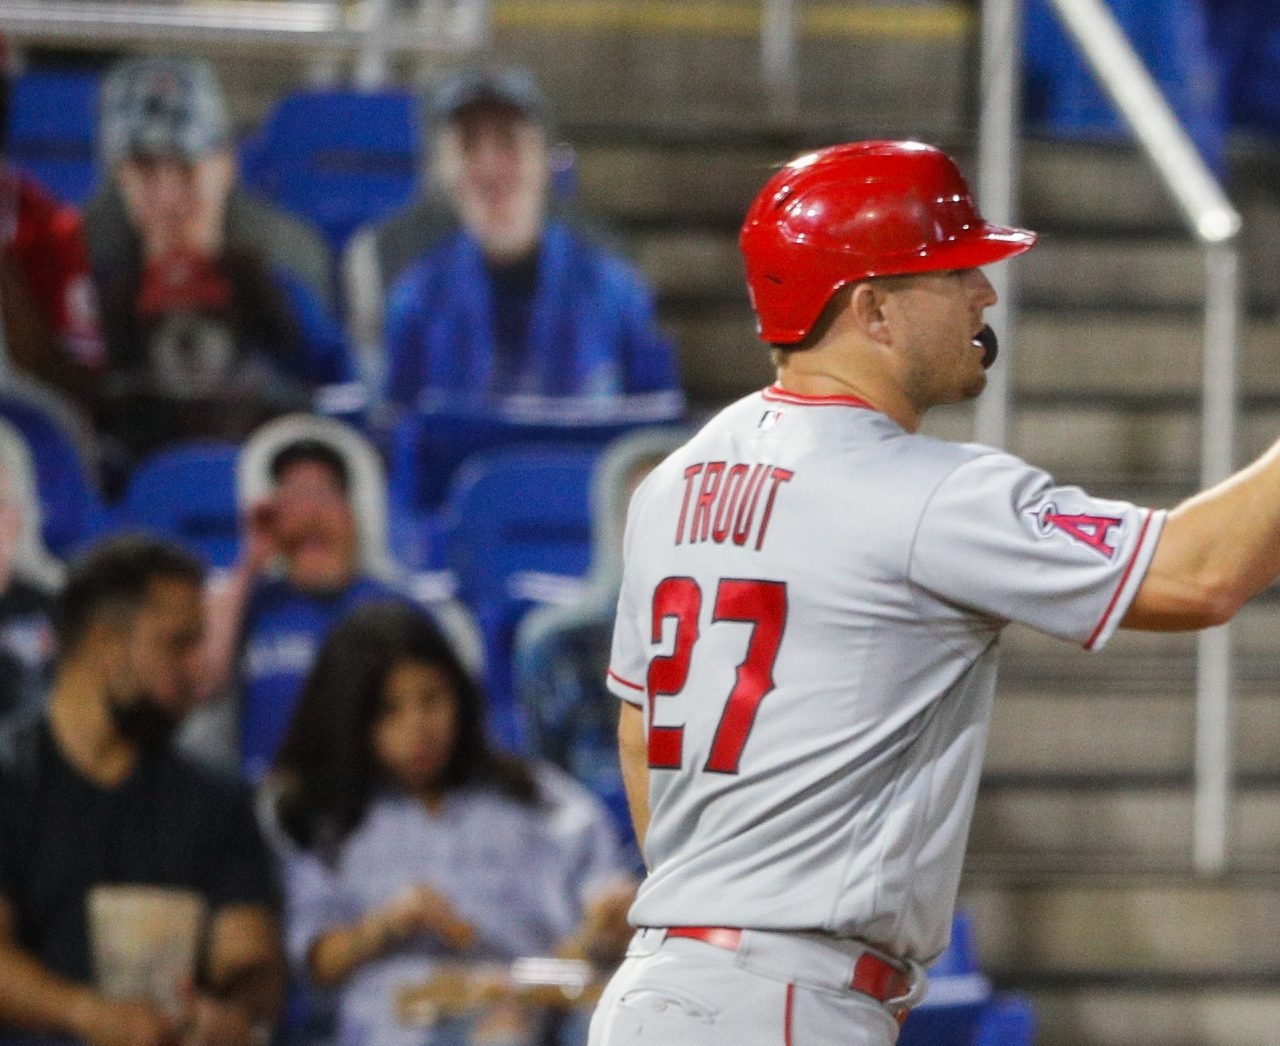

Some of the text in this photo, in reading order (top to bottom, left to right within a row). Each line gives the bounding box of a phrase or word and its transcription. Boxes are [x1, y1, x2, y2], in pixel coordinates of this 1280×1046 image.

[674, 460, 795, 551] TROUT
[1034, 505, 1122, 560] A
[647, 576, 788, 775] 27
